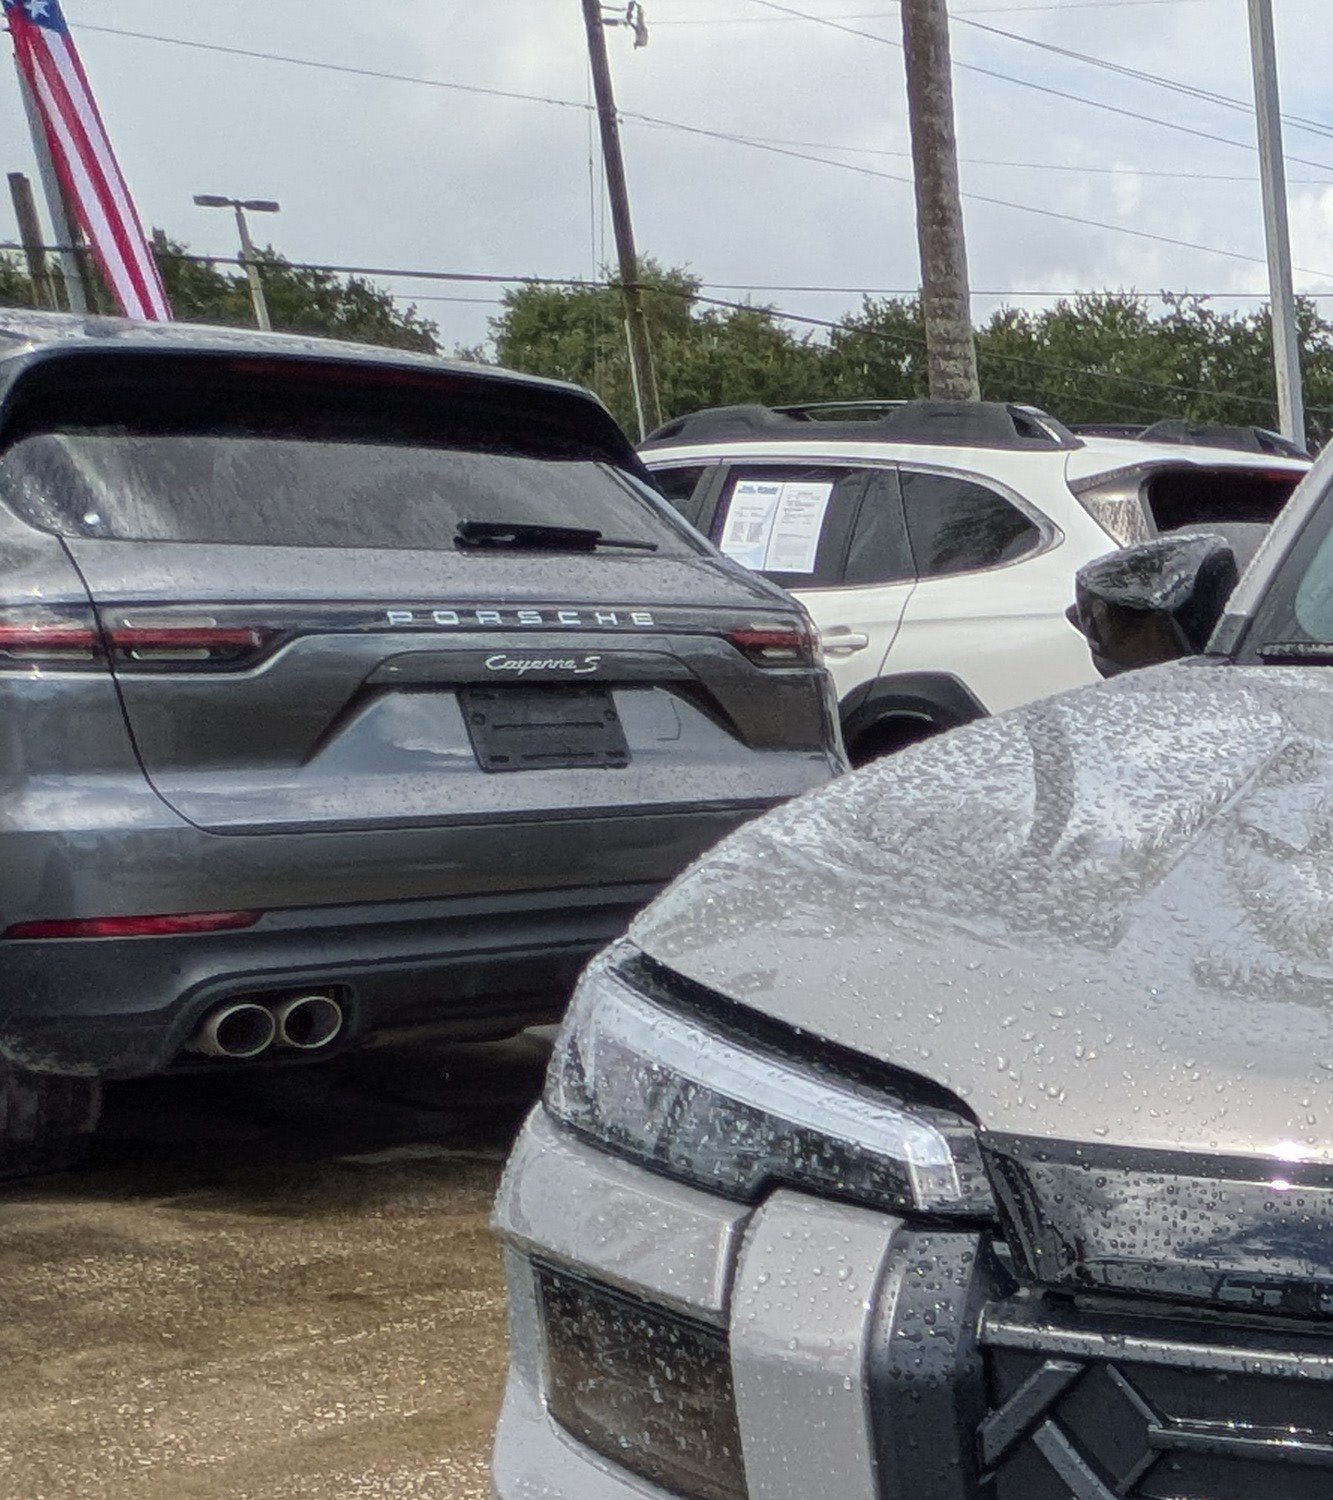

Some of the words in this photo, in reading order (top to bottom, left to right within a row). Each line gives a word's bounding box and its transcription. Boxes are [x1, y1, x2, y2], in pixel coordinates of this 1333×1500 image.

[387, 611, 654, 626] PORSCHE
[485, 655, 576, 676] Cayenne
[574, 656, 600, 674] S
